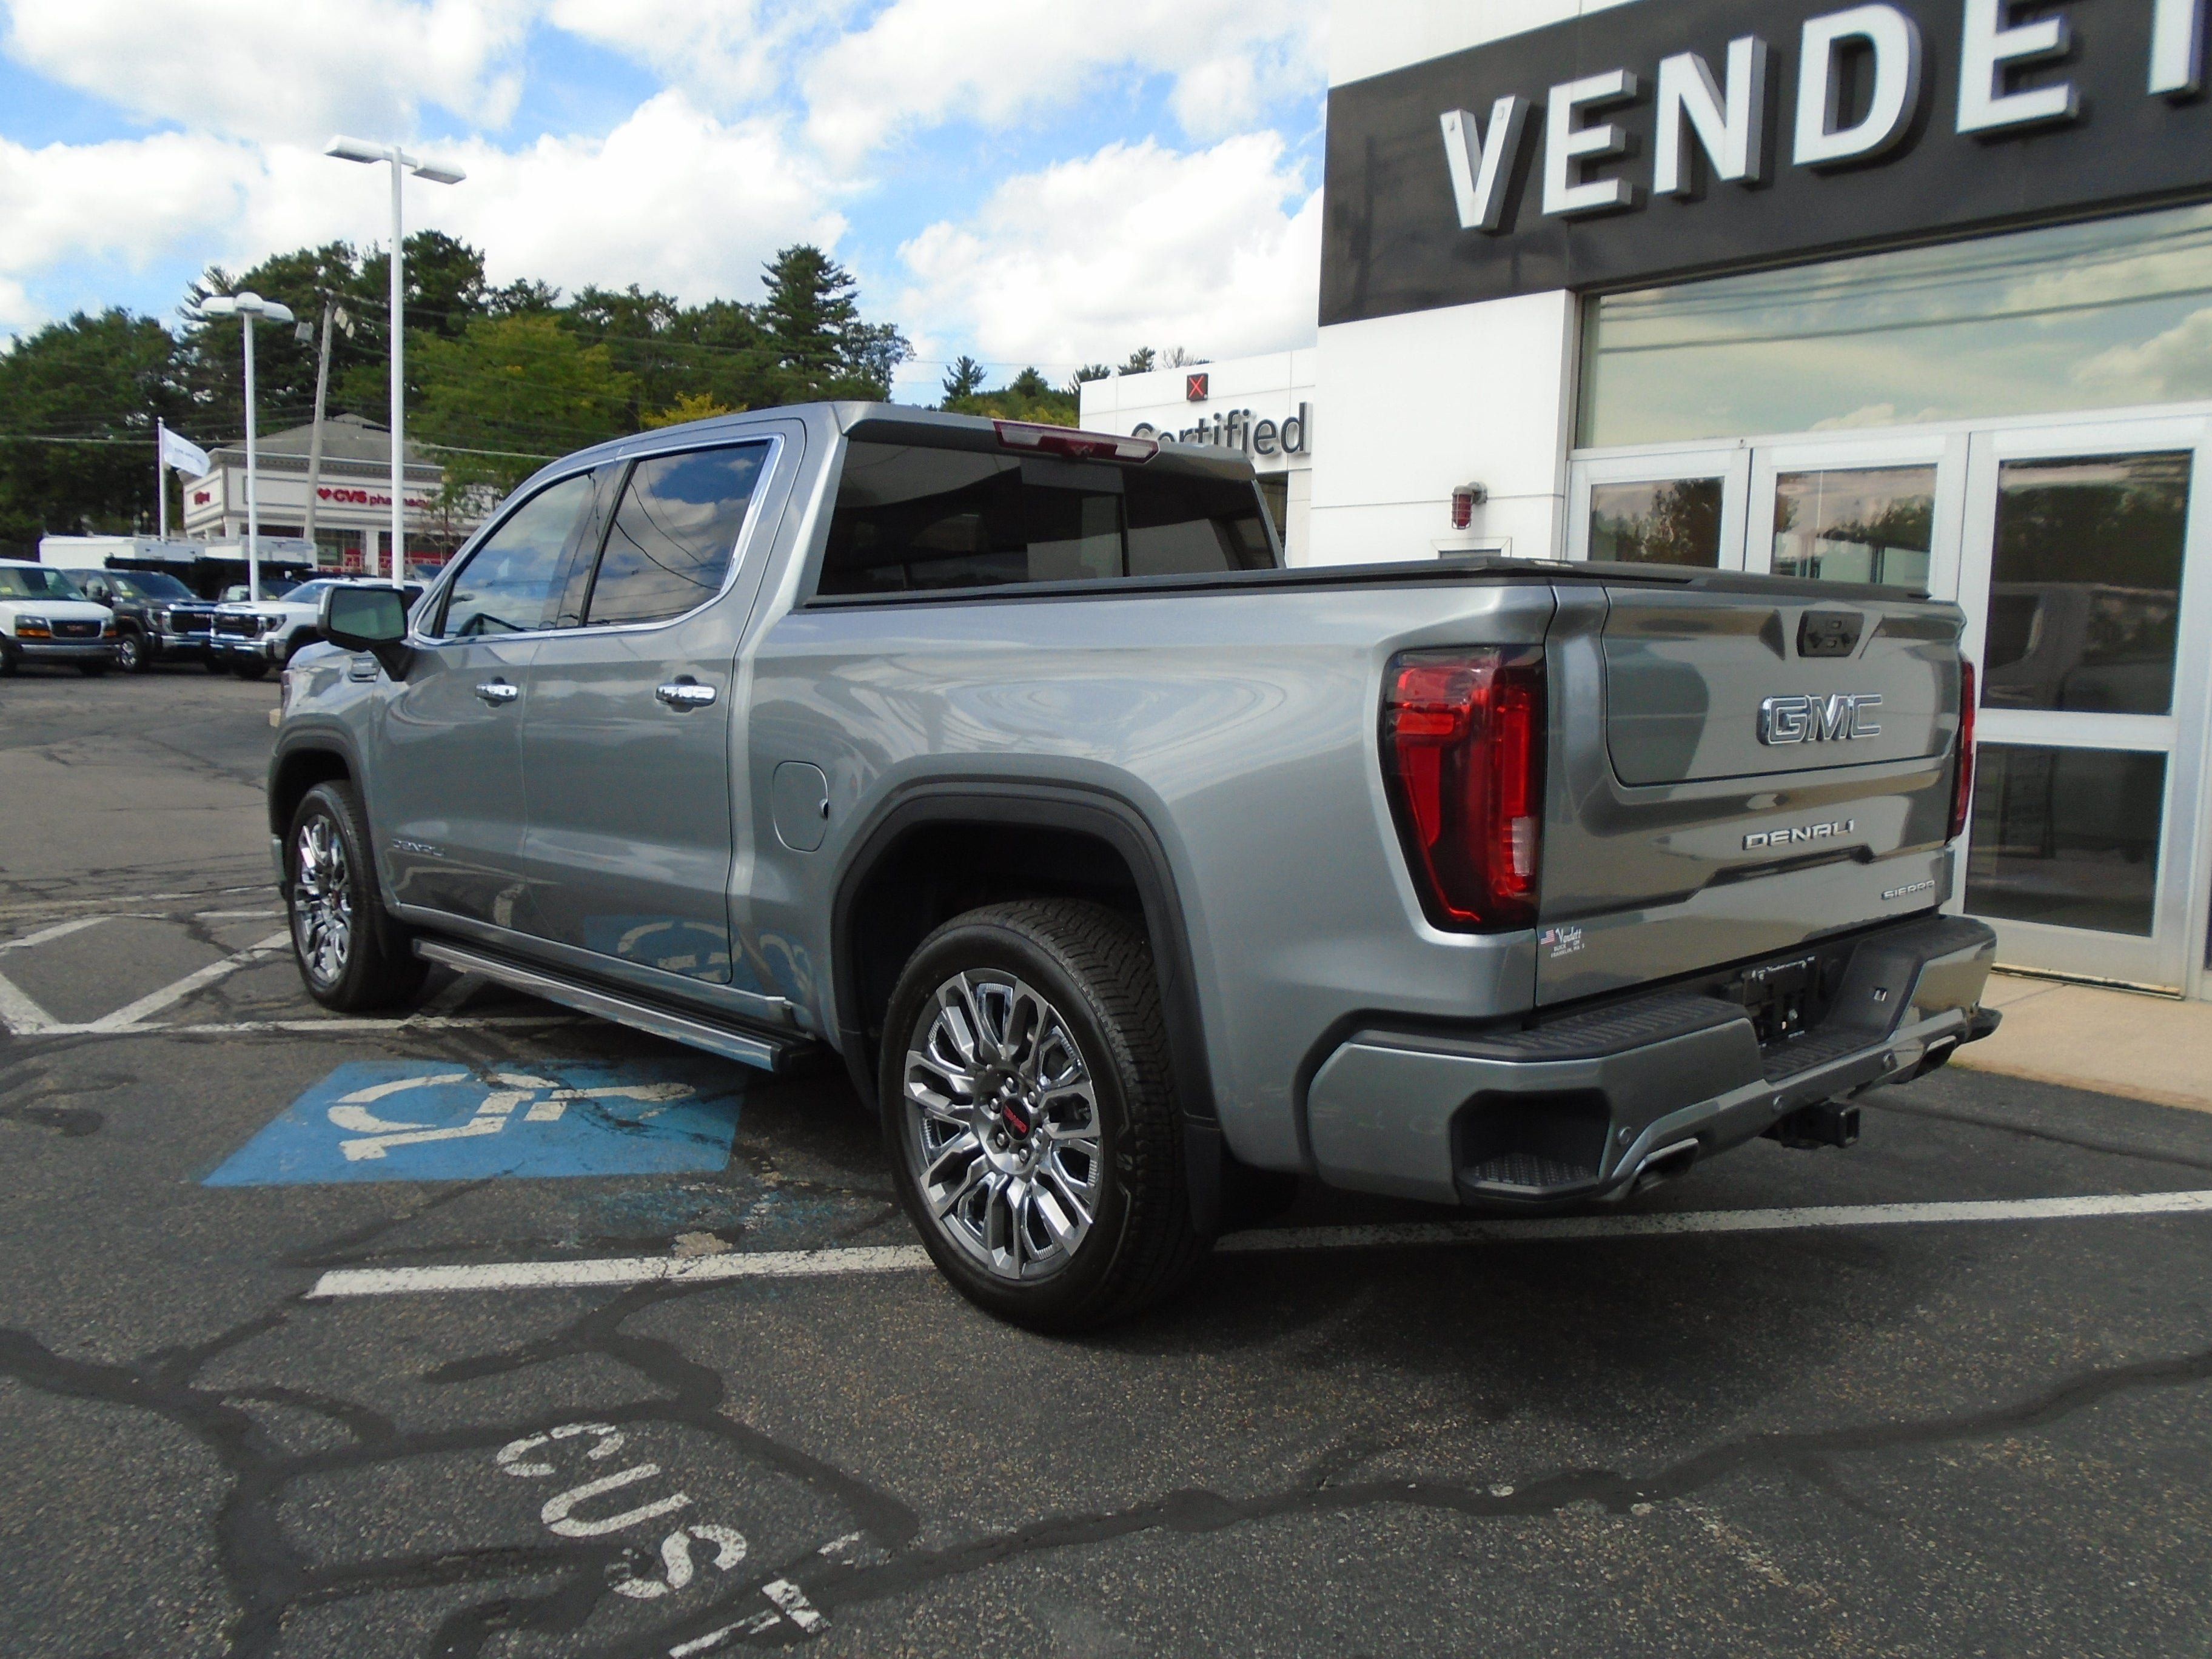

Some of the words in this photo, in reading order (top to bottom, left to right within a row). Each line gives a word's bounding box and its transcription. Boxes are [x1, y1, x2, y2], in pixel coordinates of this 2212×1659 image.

[334, 489, 366, 503] CVS
[369, 494, 432, 511] phaacy
[1757, 694, 1882, 745] GMC
[1743, 819, 1854, 850] DENALI
[1882, 879, 1935, 900] SIERRA
